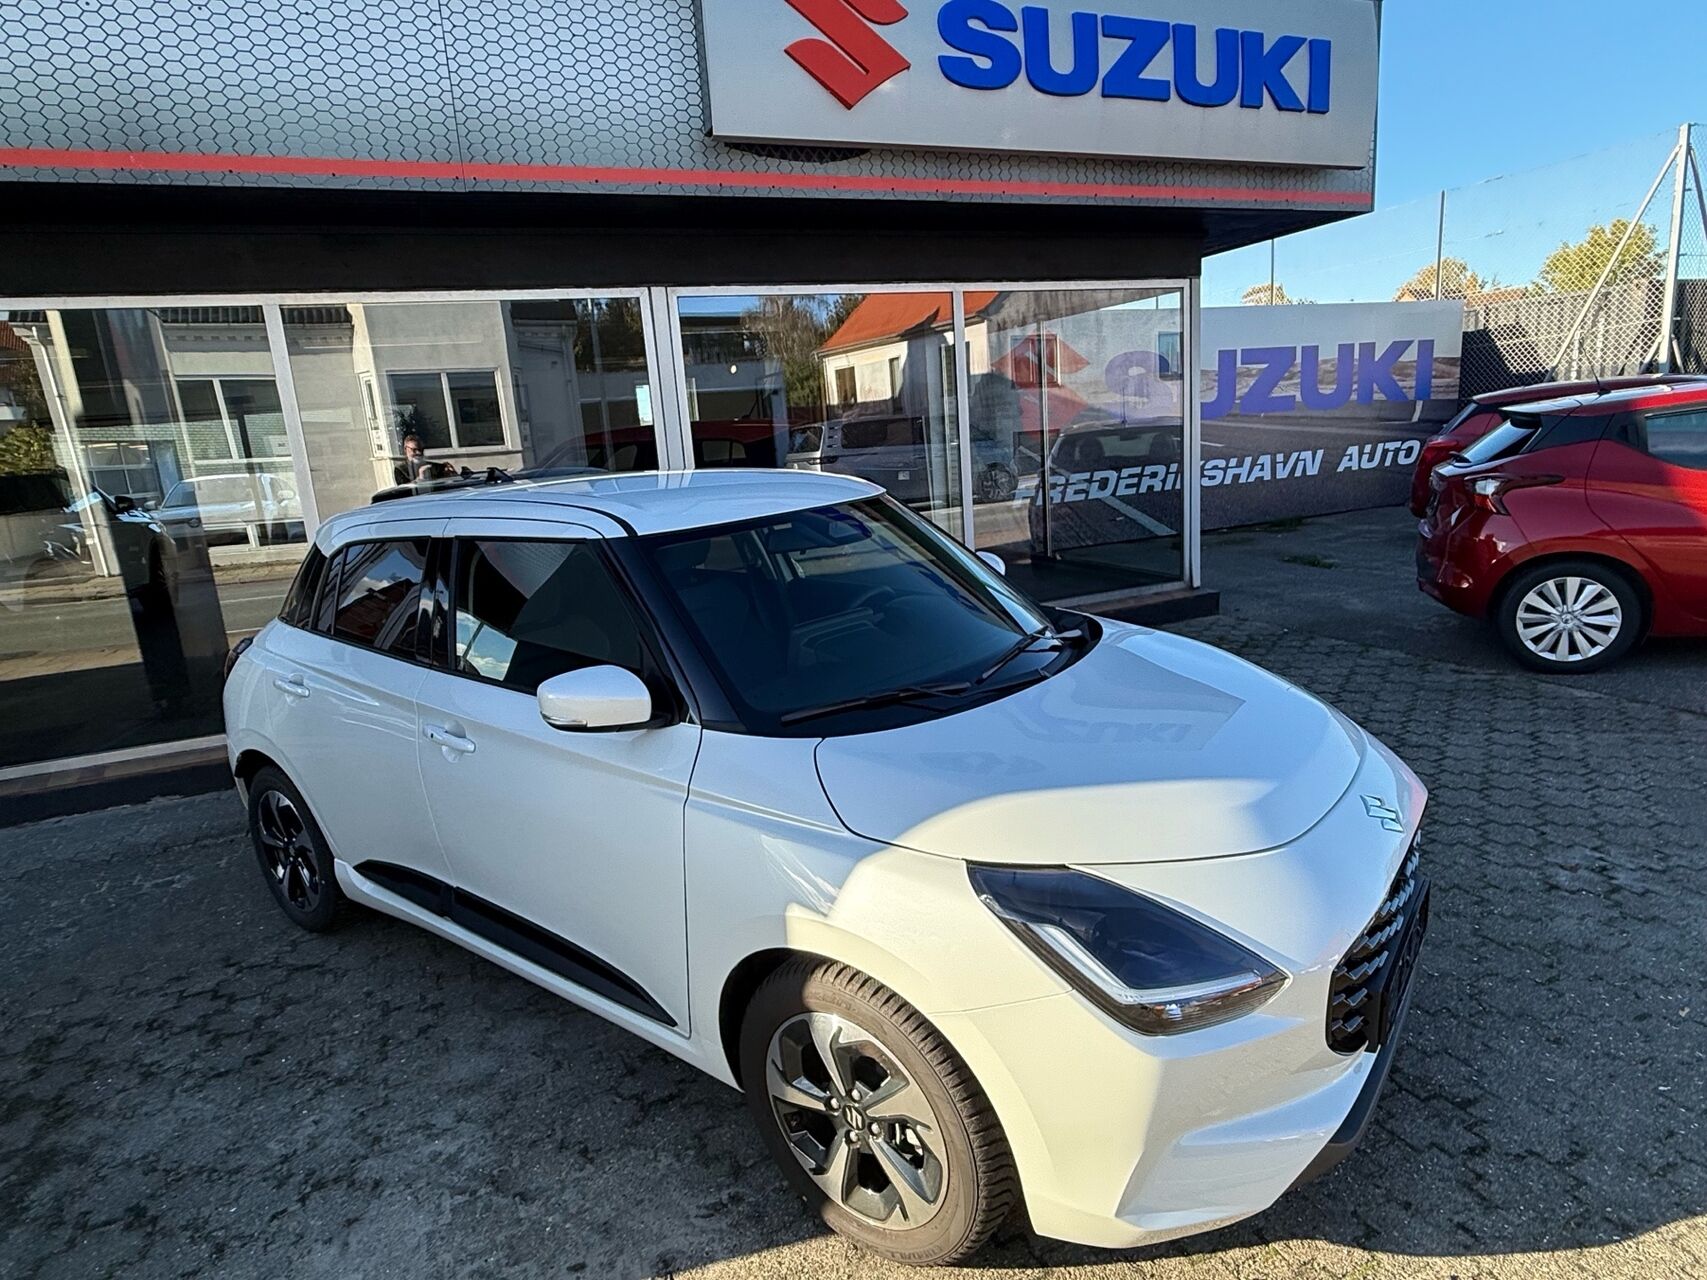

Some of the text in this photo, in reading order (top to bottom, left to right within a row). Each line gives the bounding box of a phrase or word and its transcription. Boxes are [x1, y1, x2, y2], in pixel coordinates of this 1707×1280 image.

[937, 0, 1331, 114] SUZUKI
[1014, 439, 1421, 506] FREDERISHAVN AUTO
